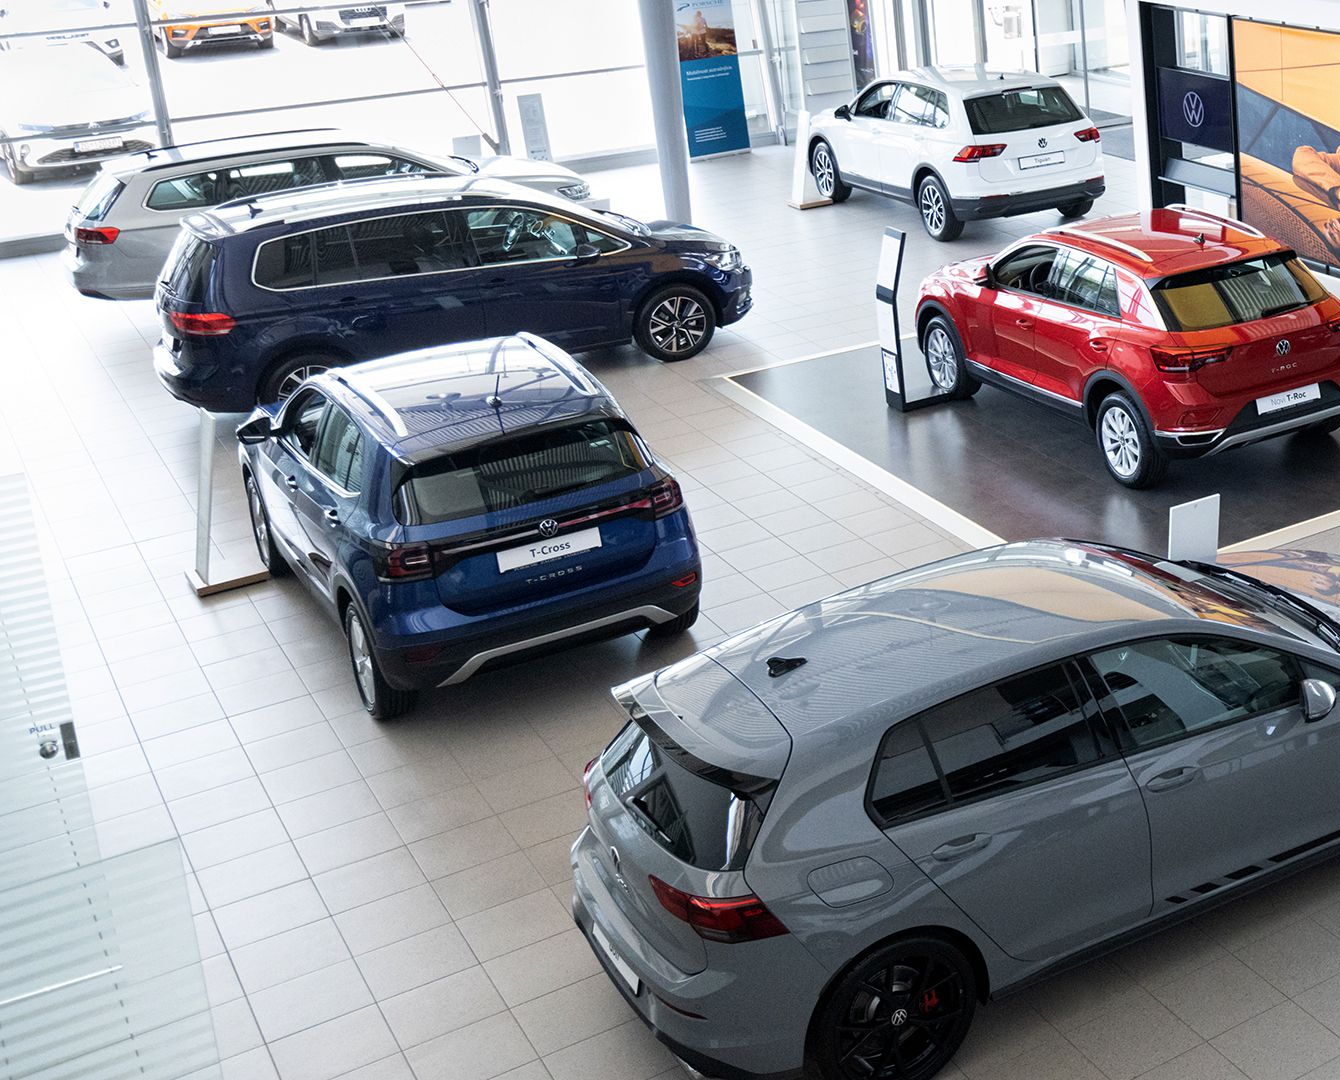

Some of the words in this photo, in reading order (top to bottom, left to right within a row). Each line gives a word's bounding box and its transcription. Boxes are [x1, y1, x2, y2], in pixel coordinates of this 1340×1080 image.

[1271, 362, 1297, 373] T-ROC
[1271, 397, 1285, 406] Novi
[1286, 391, 1307, 401] T-Roc
[529, 542, 571, 558] T-Cross
[526, 565, 583, 584] T-CROSS
[29, 723, 56, 734] PULL
